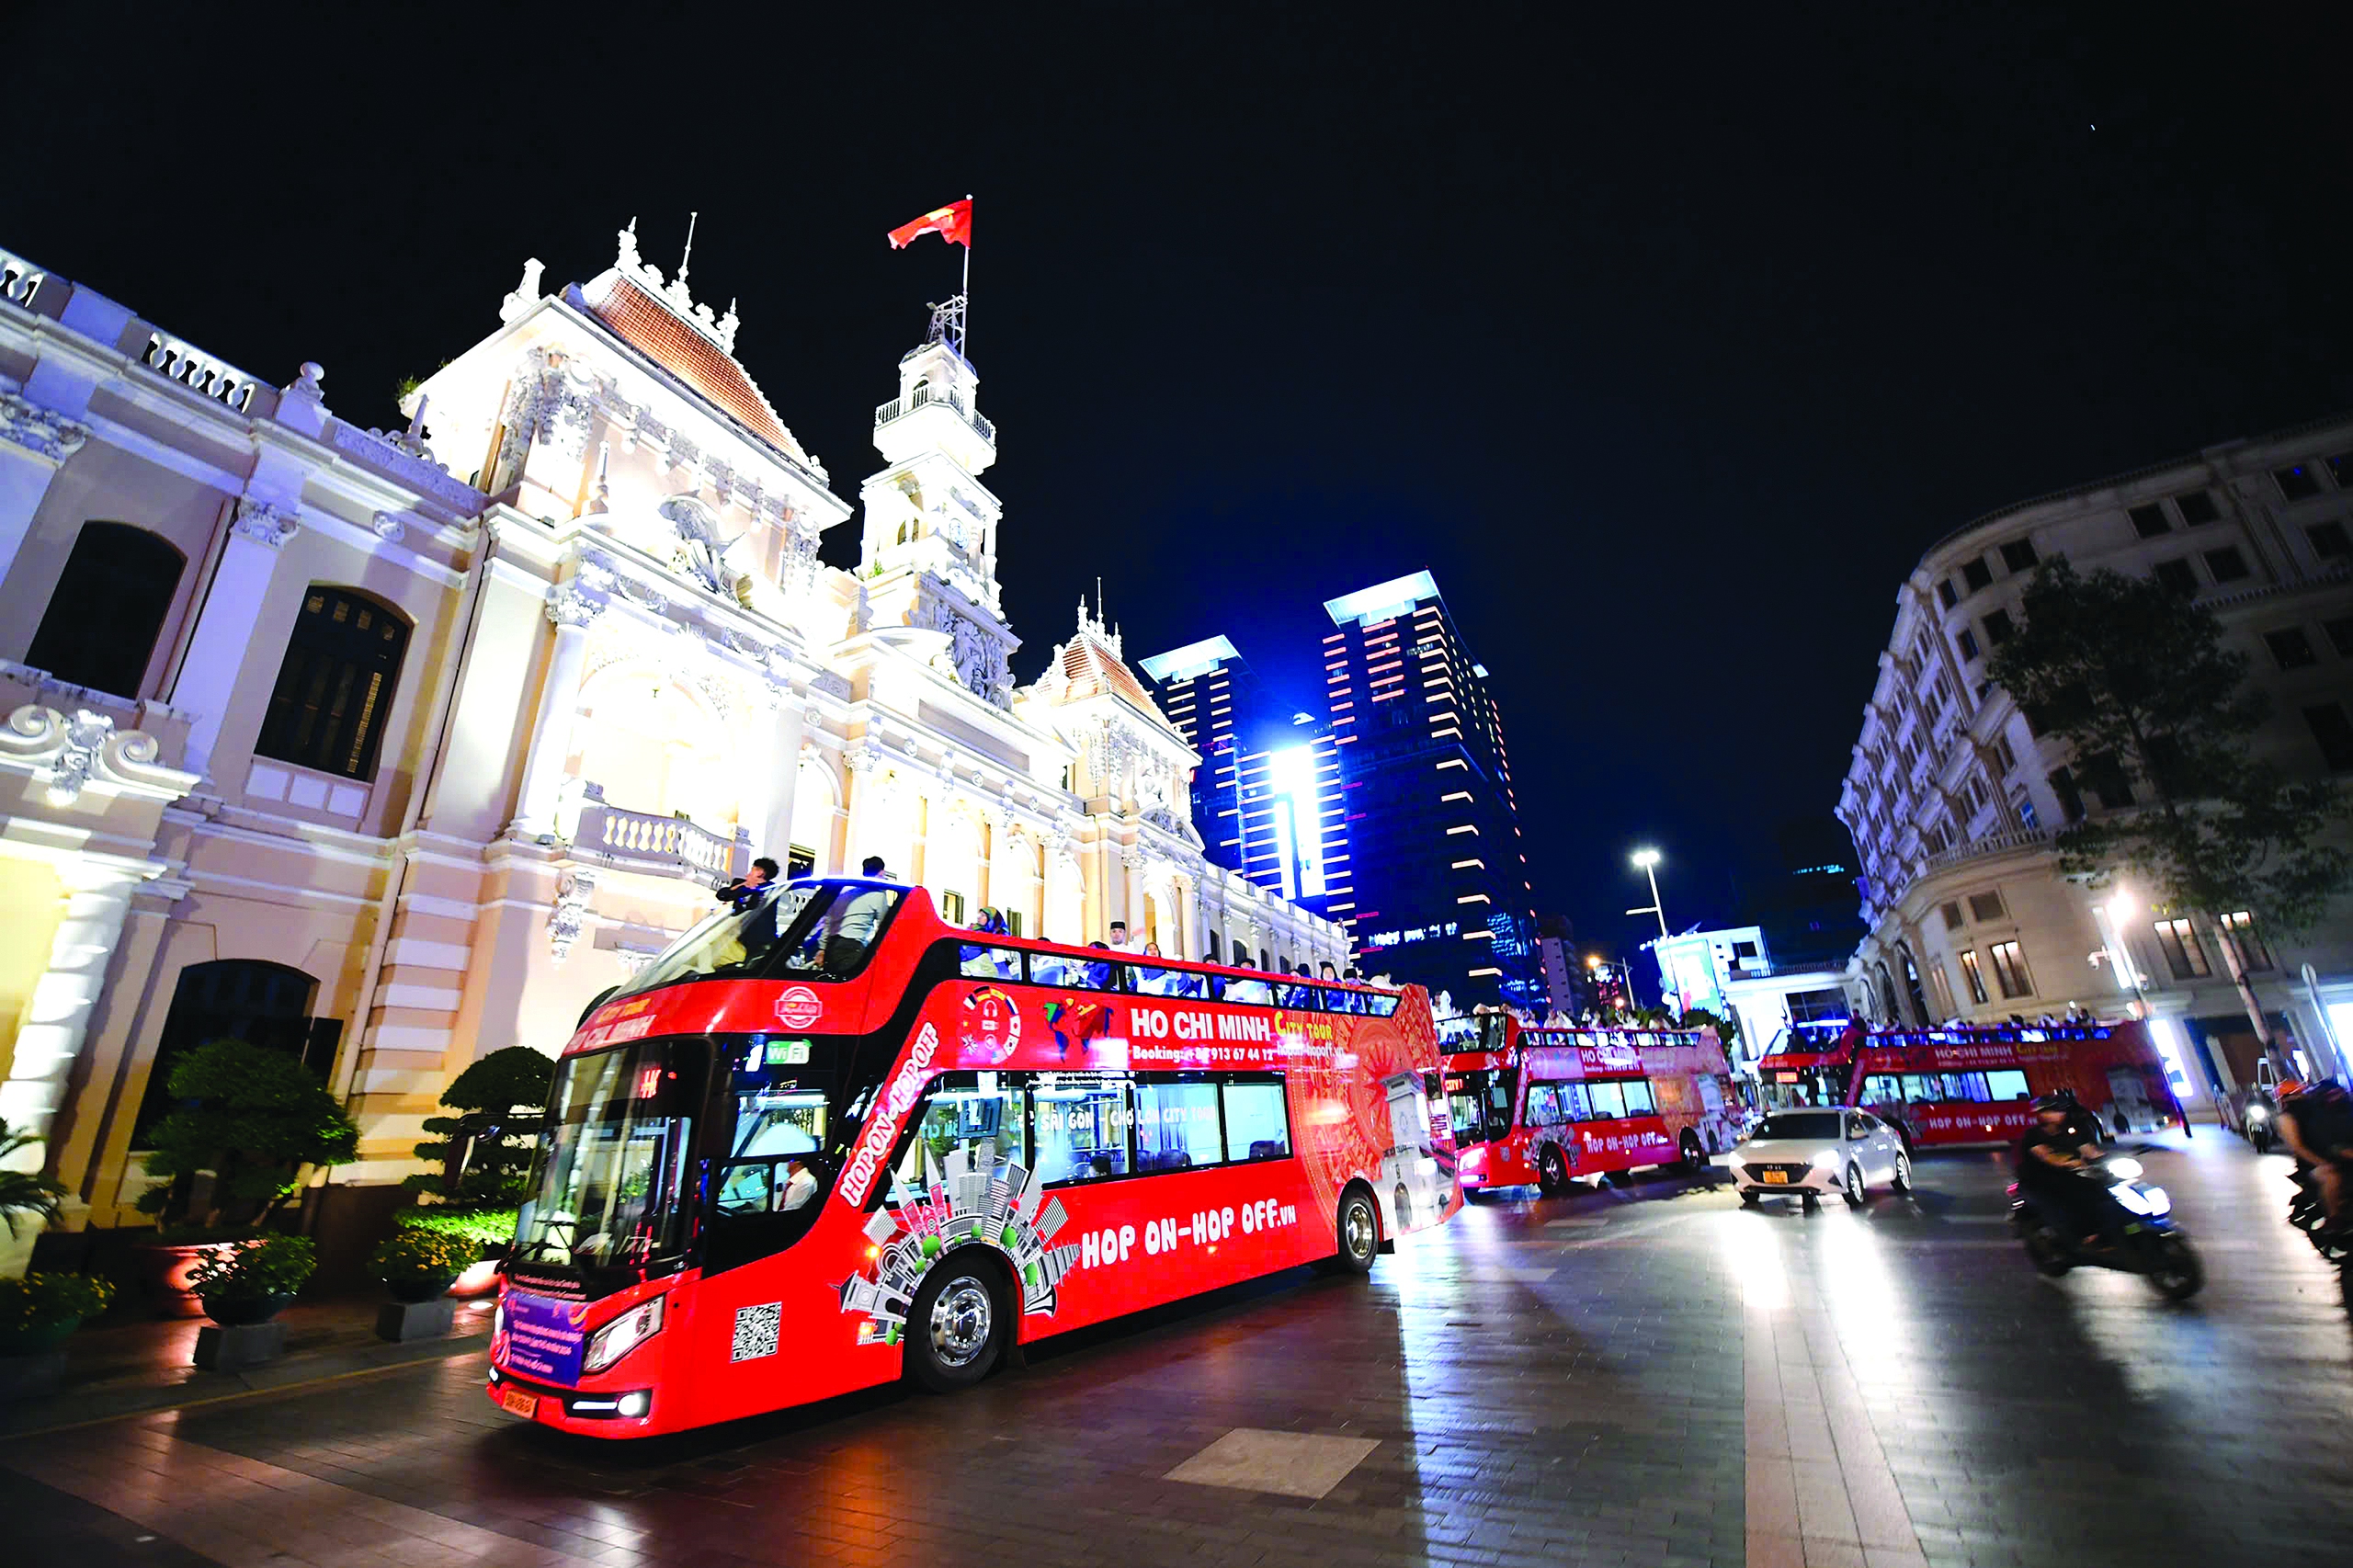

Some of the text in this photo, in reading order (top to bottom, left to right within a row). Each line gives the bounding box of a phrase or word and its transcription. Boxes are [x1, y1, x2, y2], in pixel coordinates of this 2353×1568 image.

[1131, 1007, 1168, 1039] HO
[1174, 1011, 1214, 1040] CHI
[1218, 1014, 1271, 1041] MINH
[1211, 1049, 1231, 1062] 913
[1233, 1049, 1245, 1062] 67
[1247, 1048, 1260, 1062] 44
[1262, 1049, 1274, 1062] 12
[1581, 1050, 1596, 1062] HO
[839, 1146, 876, 1207] HOP
[912, 1021, 938, 1068] OFF
[1929, 1117, 1952, 1130] HOP
[1586, 1137, 1604, 1154] HOP
[1082, 1225, 1135, 1269] HOP
